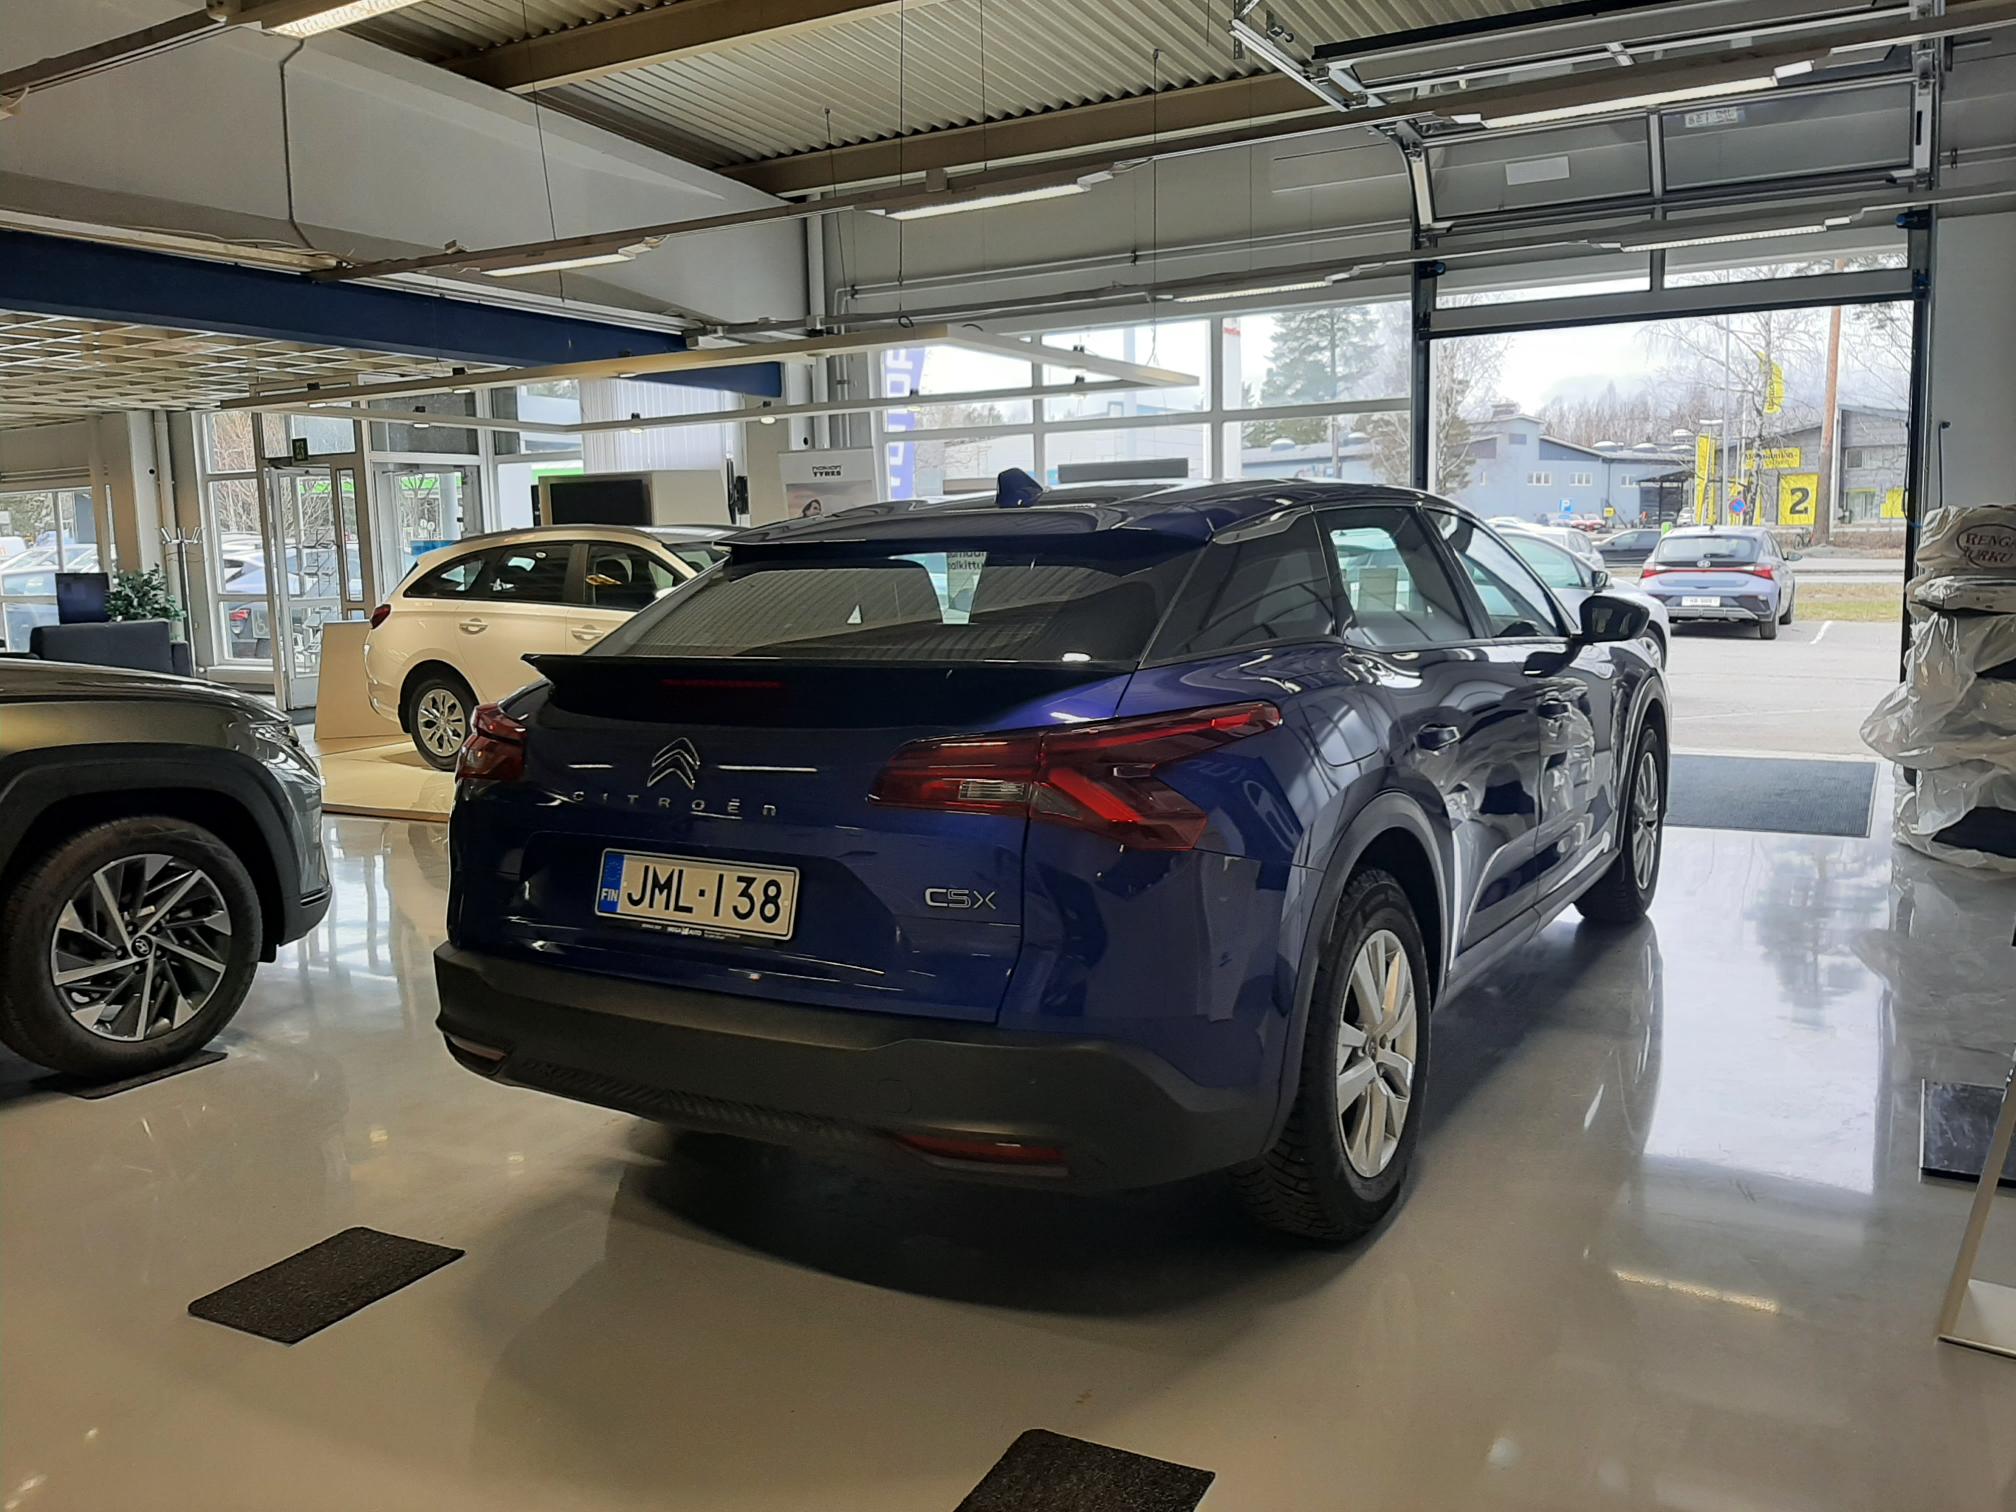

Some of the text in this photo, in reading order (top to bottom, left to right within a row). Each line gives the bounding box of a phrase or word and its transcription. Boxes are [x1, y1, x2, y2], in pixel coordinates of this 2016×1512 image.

[1789, 487, 1810, 515] 2
[1965, 533, 2016, 548] RENG
[601, 888, 618, 902] FIN
